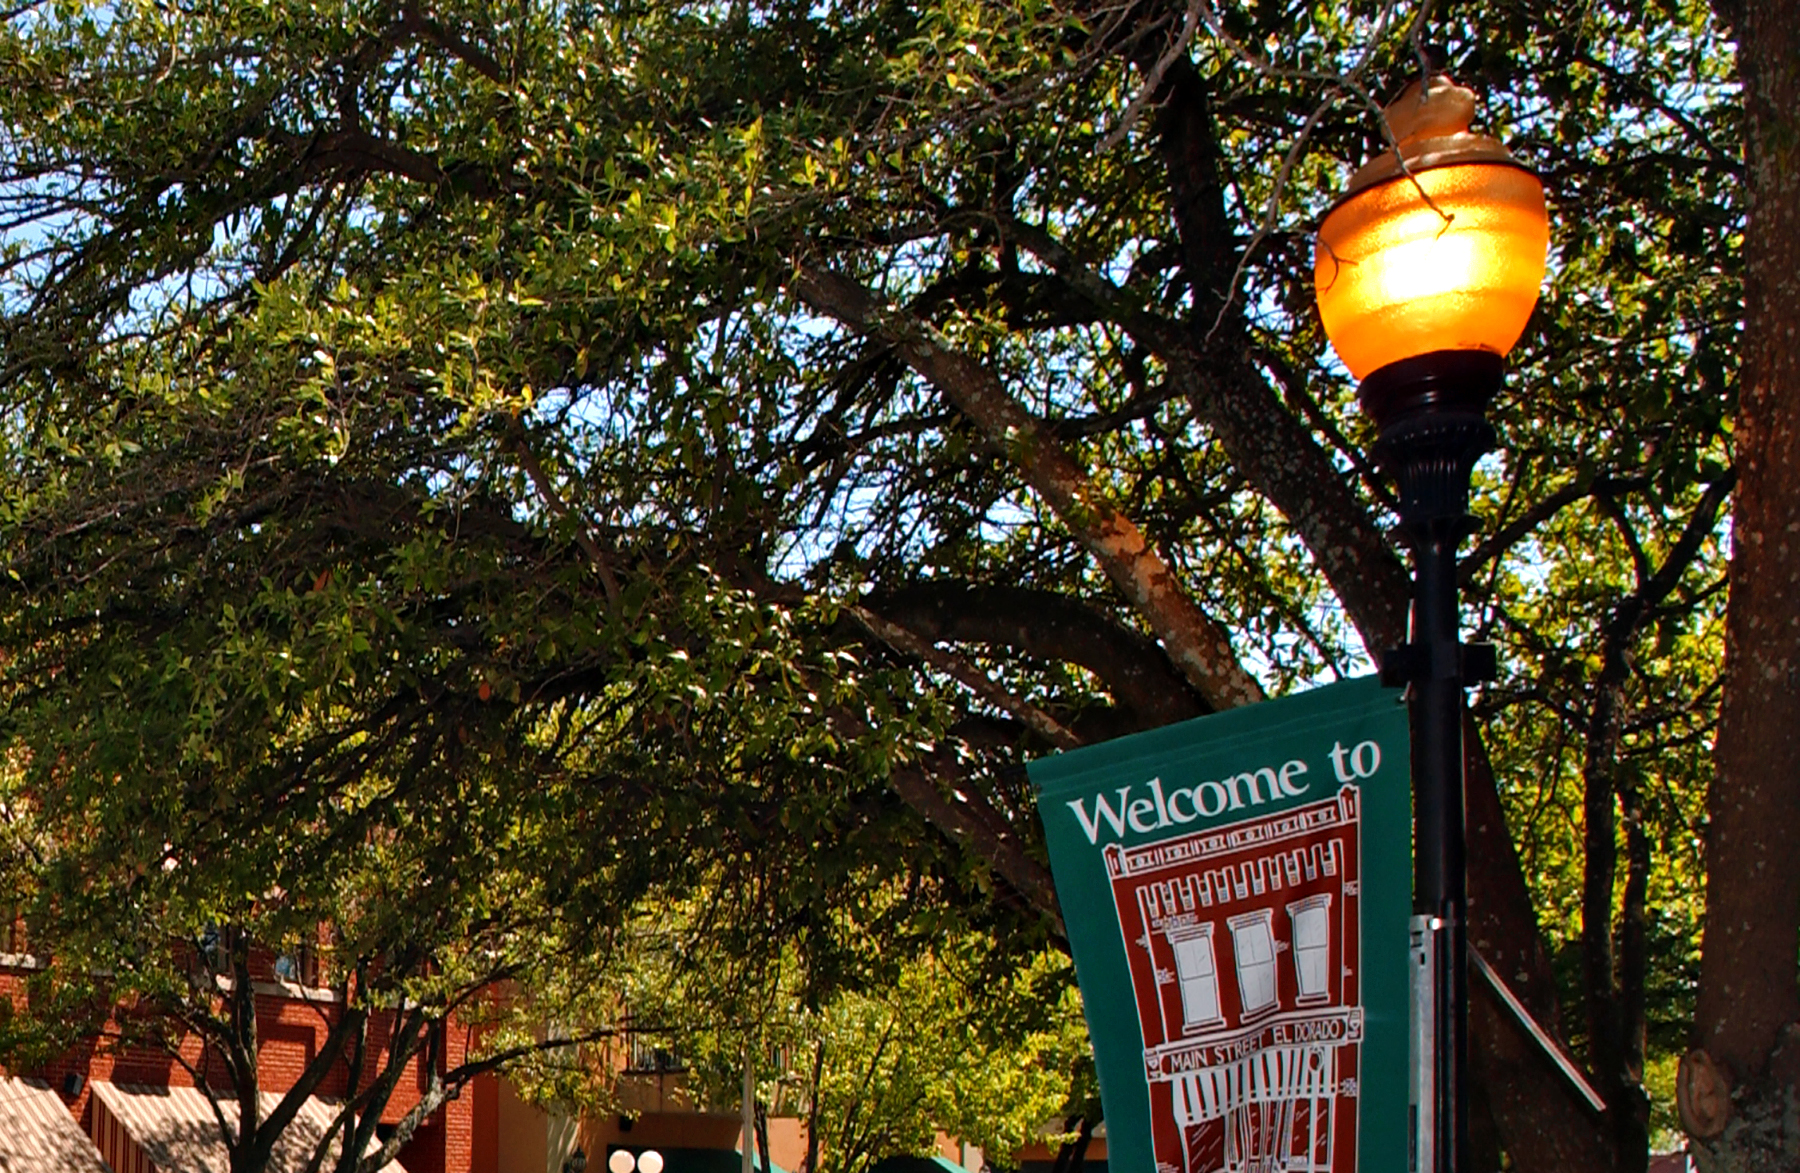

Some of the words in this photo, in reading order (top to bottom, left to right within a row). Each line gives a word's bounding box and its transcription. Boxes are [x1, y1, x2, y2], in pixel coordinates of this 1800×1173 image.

[1066, 758, 1310, 845] Welcome
[1327, 740, 1382, 783] to
[1170, 1048, 1213, 1072] MAIN
[1216, 1031, 1266, 1065] STREET
[1272, 1025, 1293, 1045] EL
[1294, 1020, 1340, 1039] DORADO
